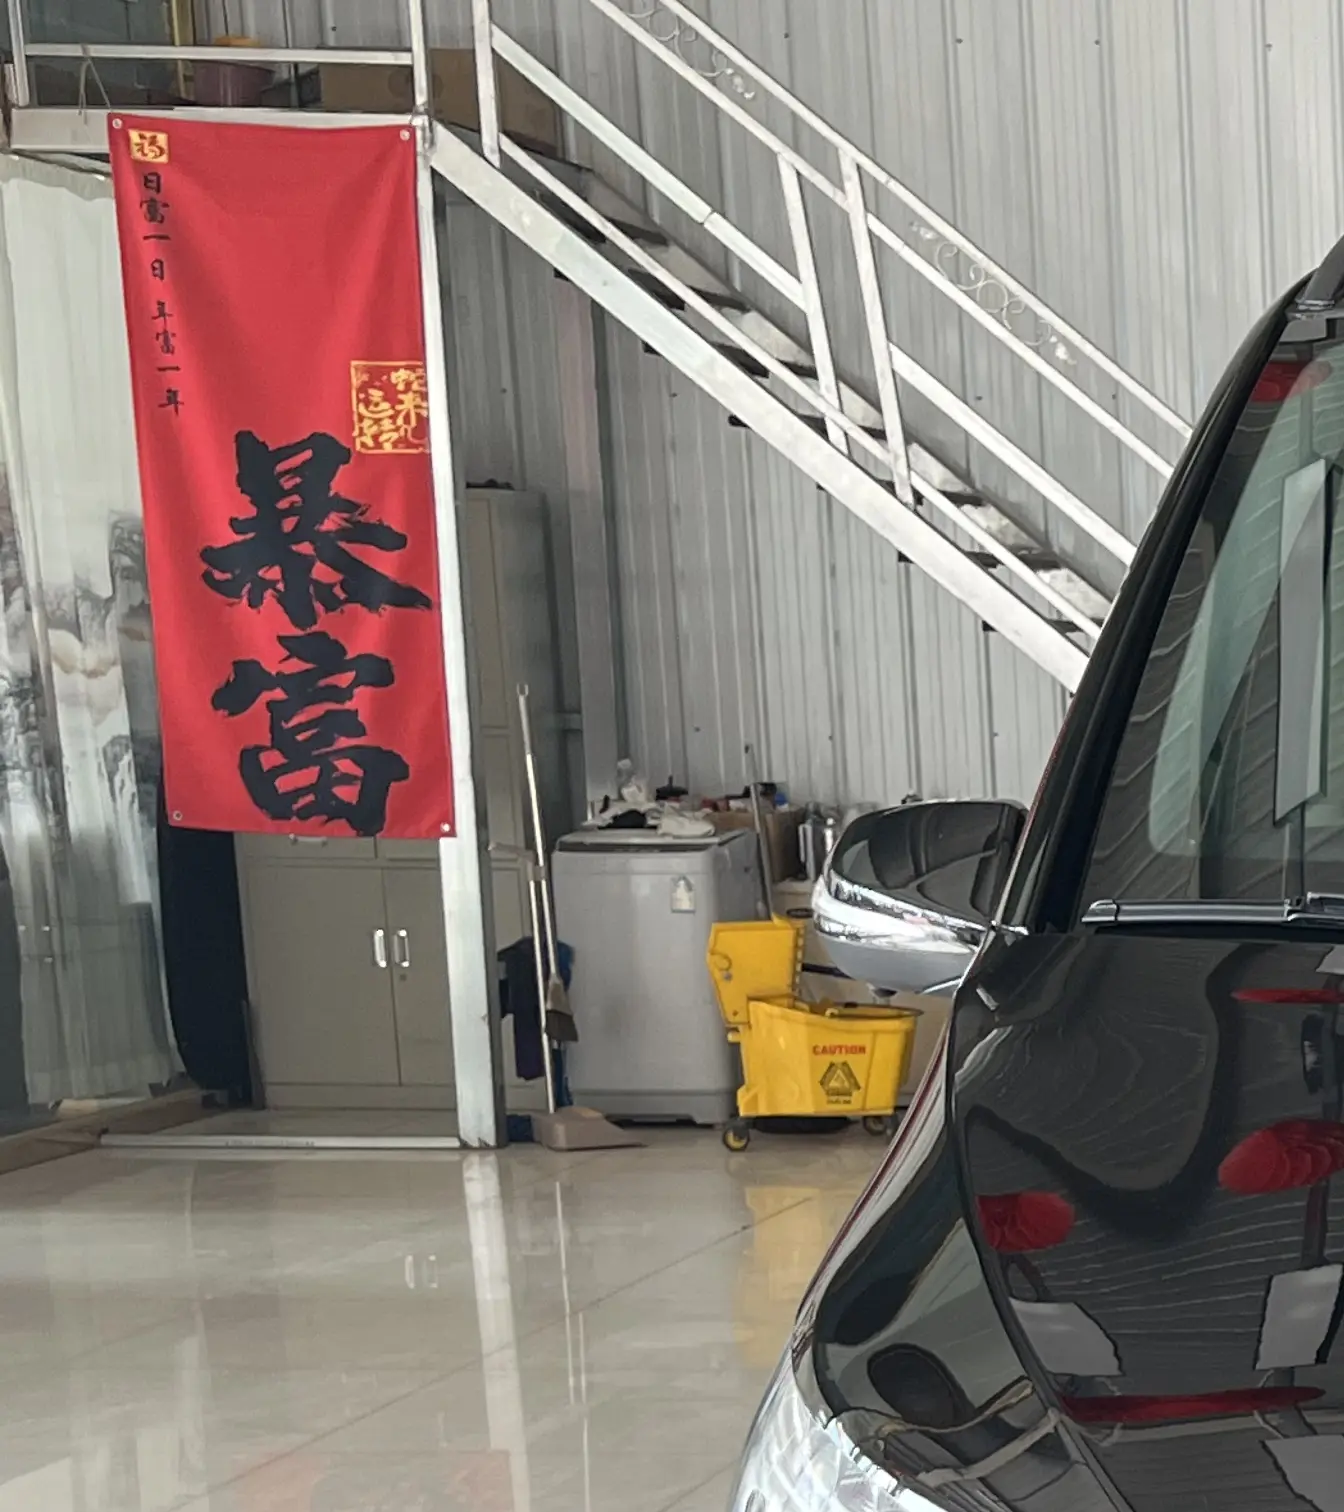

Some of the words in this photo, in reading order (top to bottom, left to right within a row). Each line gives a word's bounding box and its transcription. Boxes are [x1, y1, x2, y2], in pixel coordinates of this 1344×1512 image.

[134, 133, 165, 159] 福
[200, 430, 433, 836] 暴富
[812, 1044, 867, 1056] CAUTION
